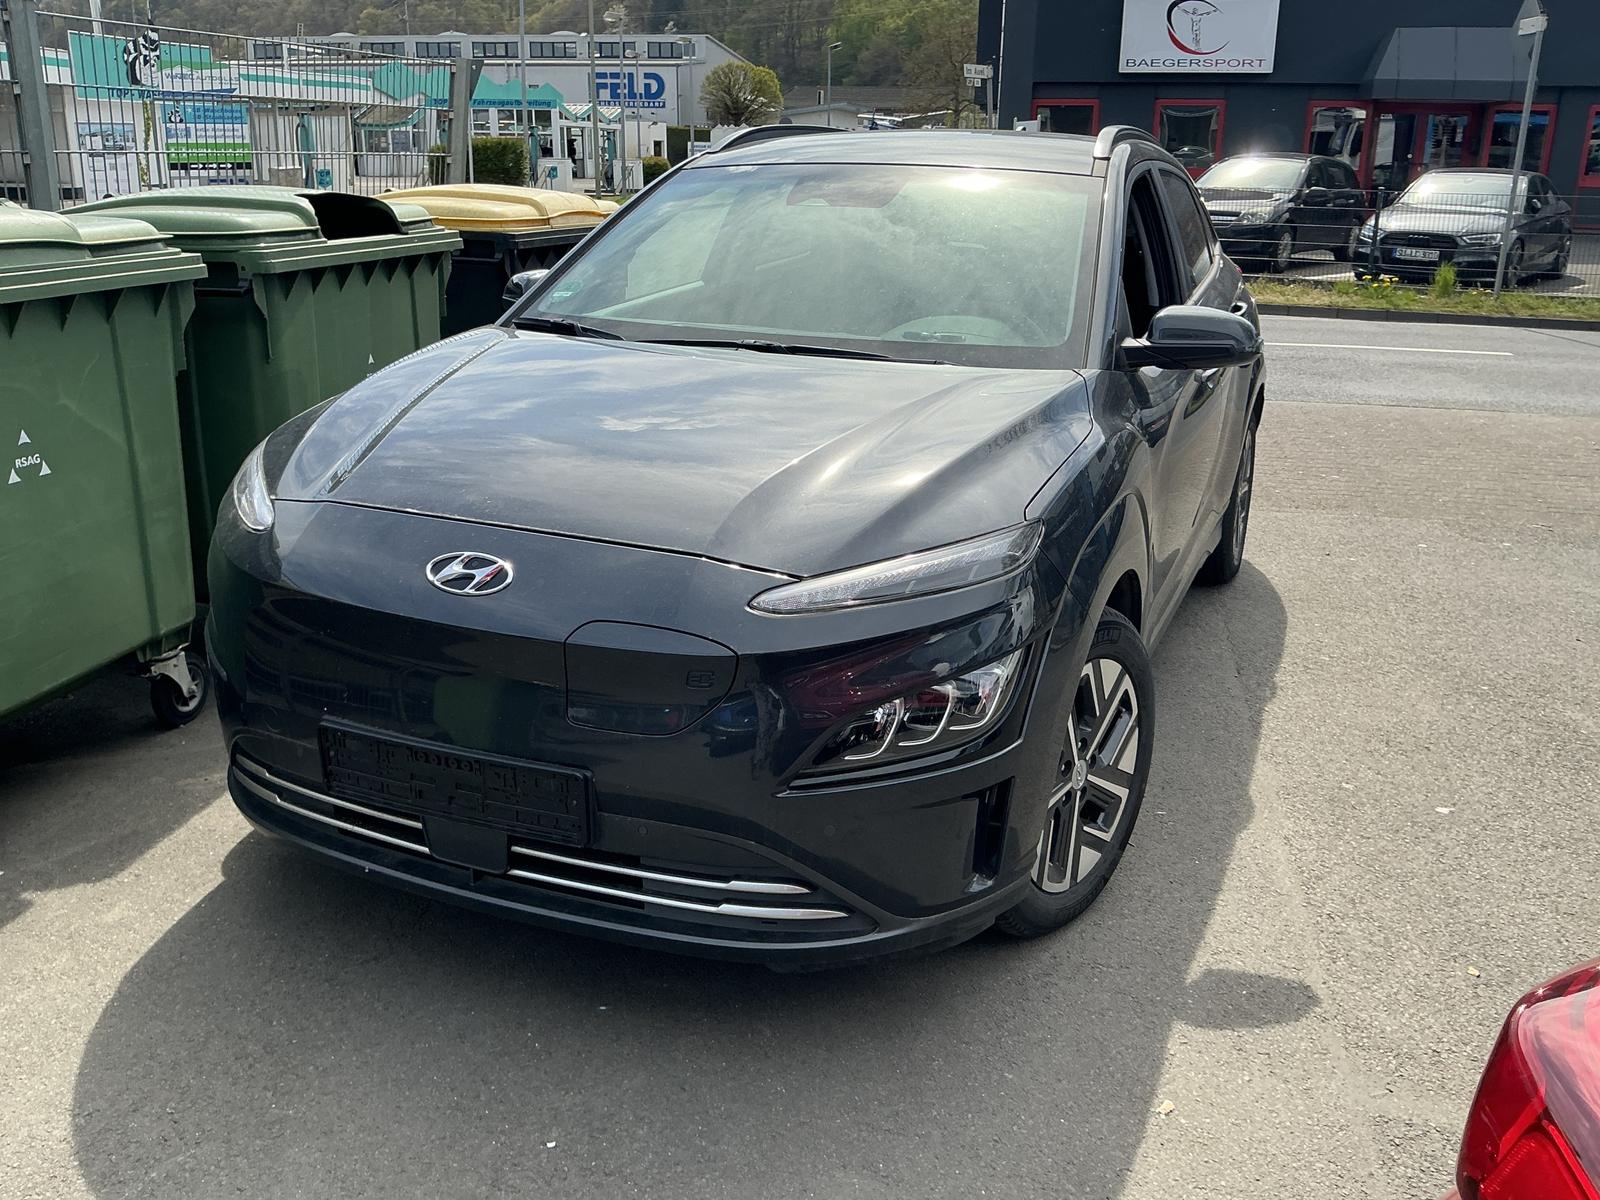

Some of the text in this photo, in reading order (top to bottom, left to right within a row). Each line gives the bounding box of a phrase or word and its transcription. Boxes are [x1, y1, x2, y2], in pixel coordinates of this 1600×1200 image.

[1125, 58, 1267, 68] BAEGERSPORT
[595, 72, 666, 100] FELD
[473, 99, 552, 107] Fahrzeugaufbreitung
[15, 453, 41, 469] RSAG
